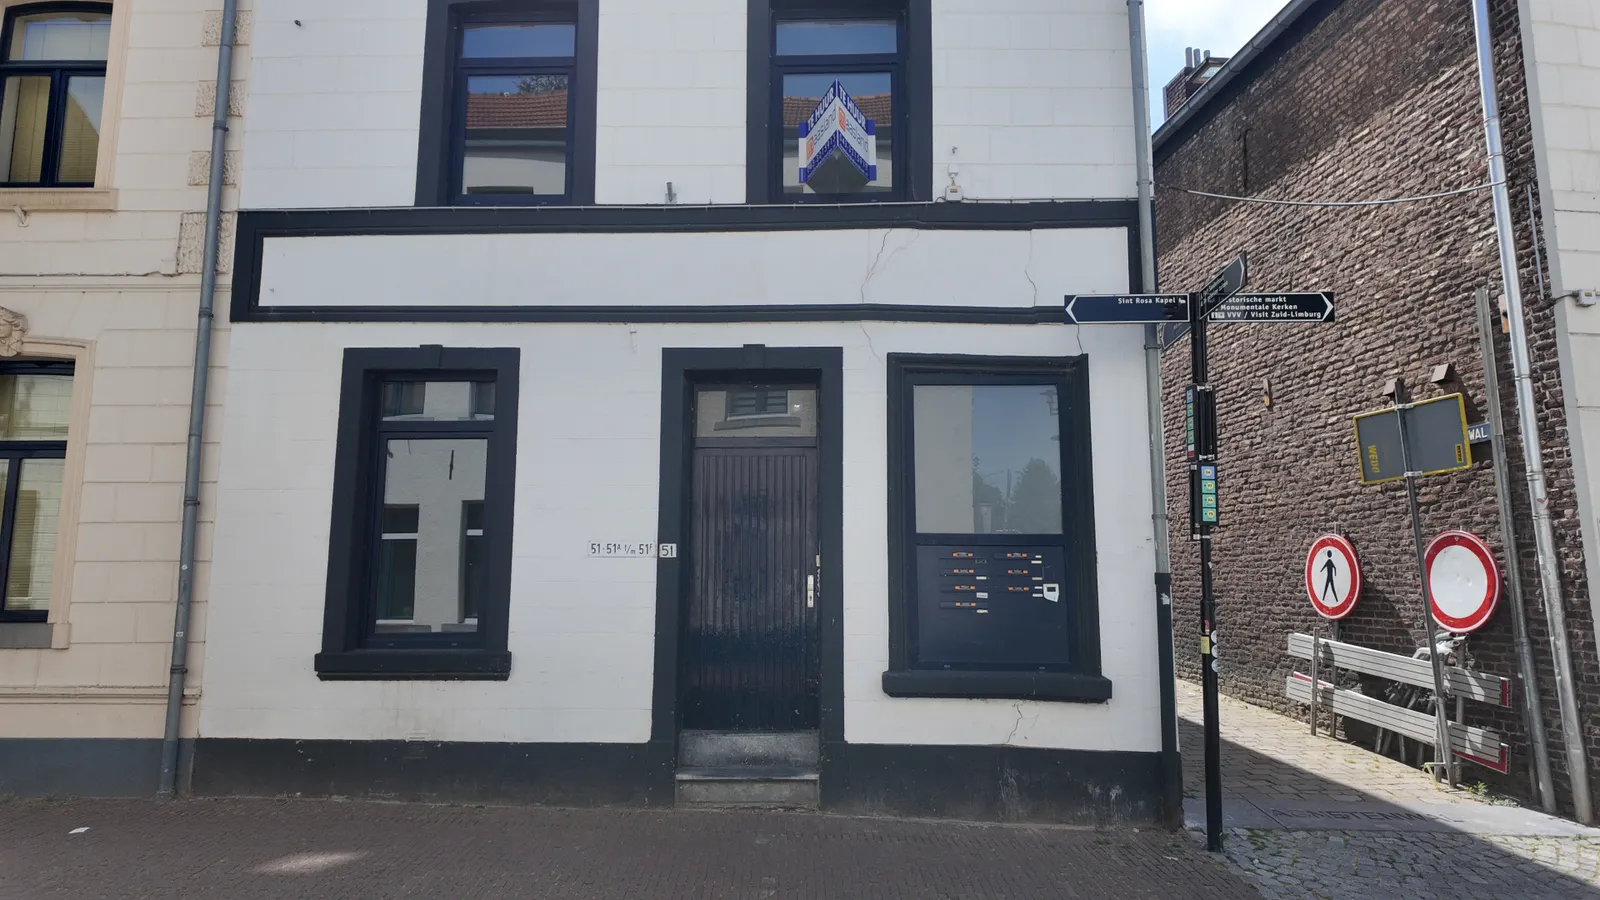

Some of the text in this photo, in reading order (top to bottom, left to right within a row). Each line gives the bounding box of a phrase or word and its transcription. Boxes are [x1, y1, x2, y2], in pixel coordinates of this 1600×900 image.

[807, 115, 815, 132] TE
[815, 87, 835, 120] HUUR
[838, 85, 847, 106] TE
[847, 96, 867, 131] HUUR
[1117, 297, 1133, 305] Sint
[1155, 296, 1176, 305] Kapel
[1227, 311, 1242, 319] VVV
[1271, 311, 1322, 320] Zuid-Limburg
[661, 545, 673, 556] 51
